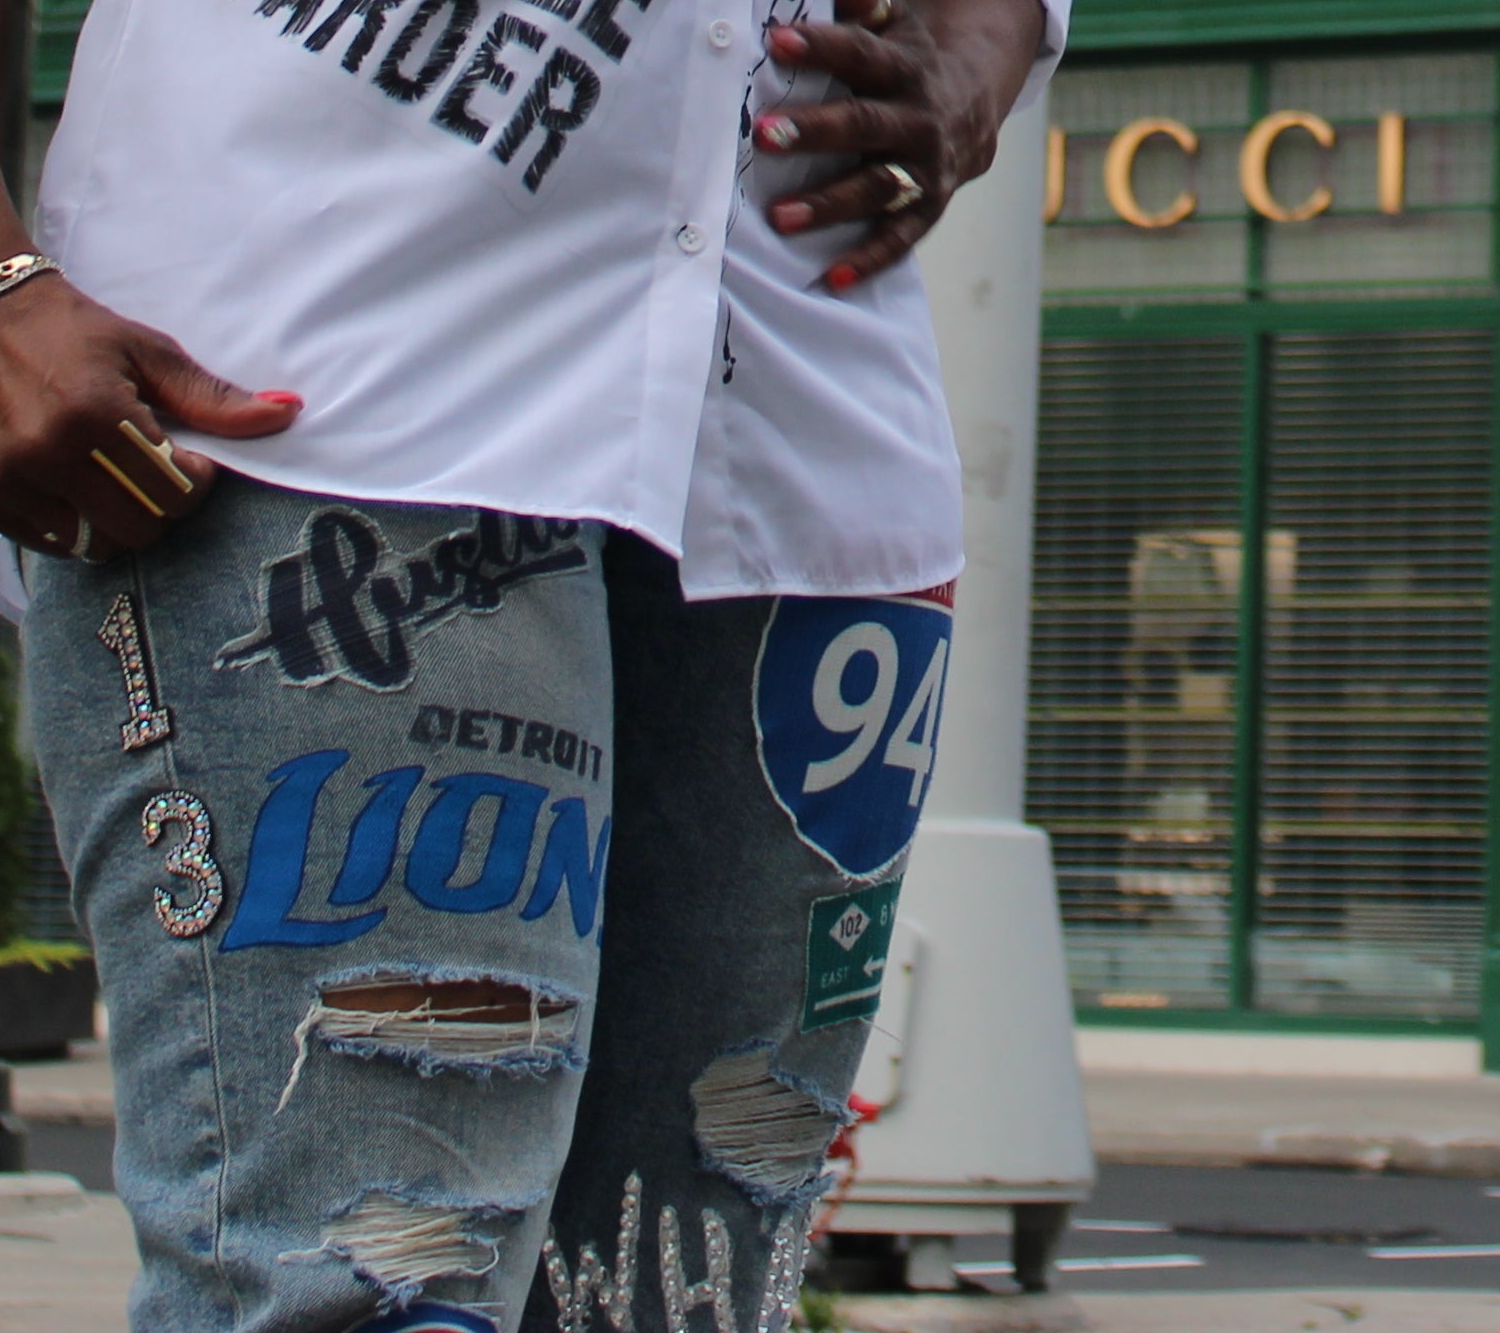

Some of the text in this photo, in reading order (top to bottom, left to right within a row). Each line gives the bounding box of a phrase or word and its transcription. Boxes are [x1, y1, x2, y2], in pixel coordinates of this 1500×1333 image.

[408, 703, 603, 782] DETROIT
[803, 621, 948, 808] 94
[218, 748, 611, 952] LION
[841, 913, 863, 939] 102
[821, 965, 851, 989] EAST
